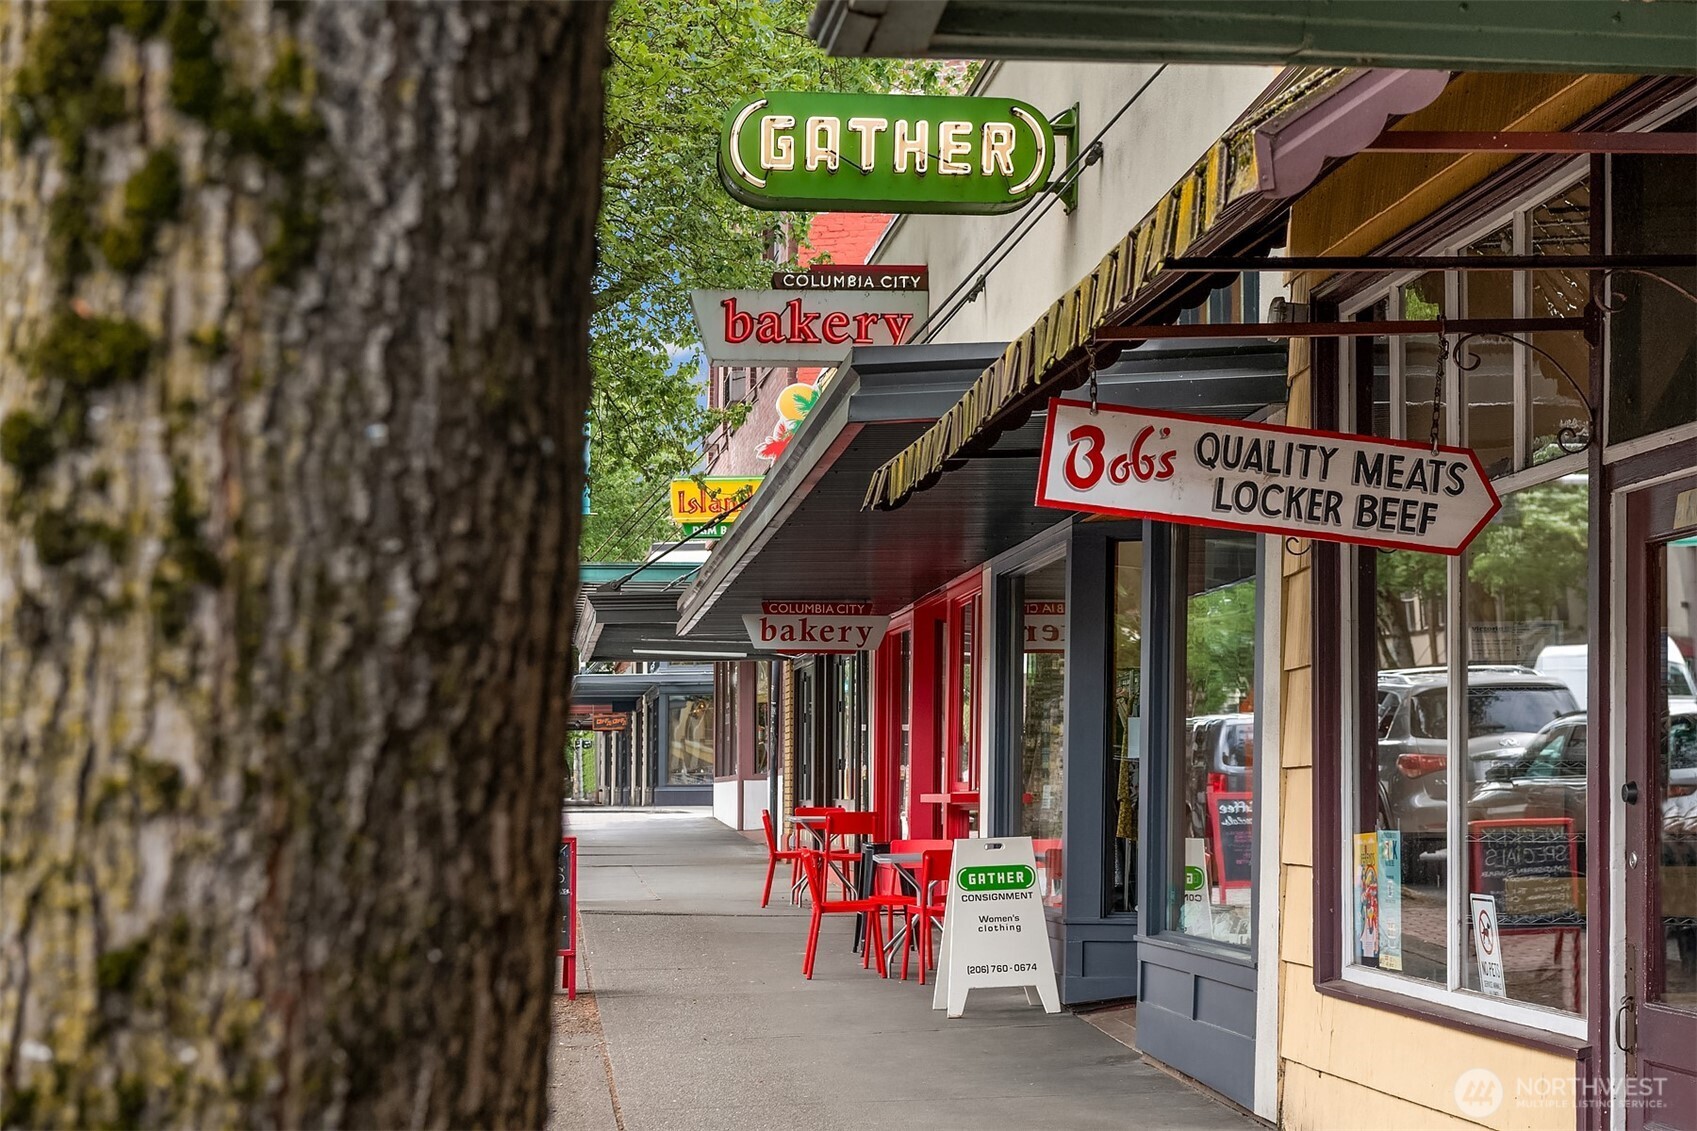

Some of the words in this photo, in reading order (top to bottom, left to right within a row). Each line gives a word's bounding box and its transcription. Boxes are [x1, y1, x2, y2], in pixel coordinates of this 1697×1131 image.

[760, 115, 1016, 177] GATHER
[783, 271, 874, 288] COLUMBIA
[880, 274, 921, 289] CITY
[721, 296, 914, 345] bakery
[1063, 424, 1177, 491] Bob's
[1195, 432, 1340, 480] QUALITY
[1354, 449, 1468, 497] MEATS
[1212, 477, 1343, 525] LOCKER
[1355, 494, 1439, 536] BEEF
[769, 603, 834, 614] COLUMBIA
[837, 604, 865, 614] CITY
[759, 617, 874, 648] bakery
[968, 871, 1025, 885] GATHER
[961, 891, 1034, 903] CONSIGNMENT
[978, 914, 1020, 923] Women's
[978, 924, 1022, 932] clothing
[967, 964, 989, 975] (206)
